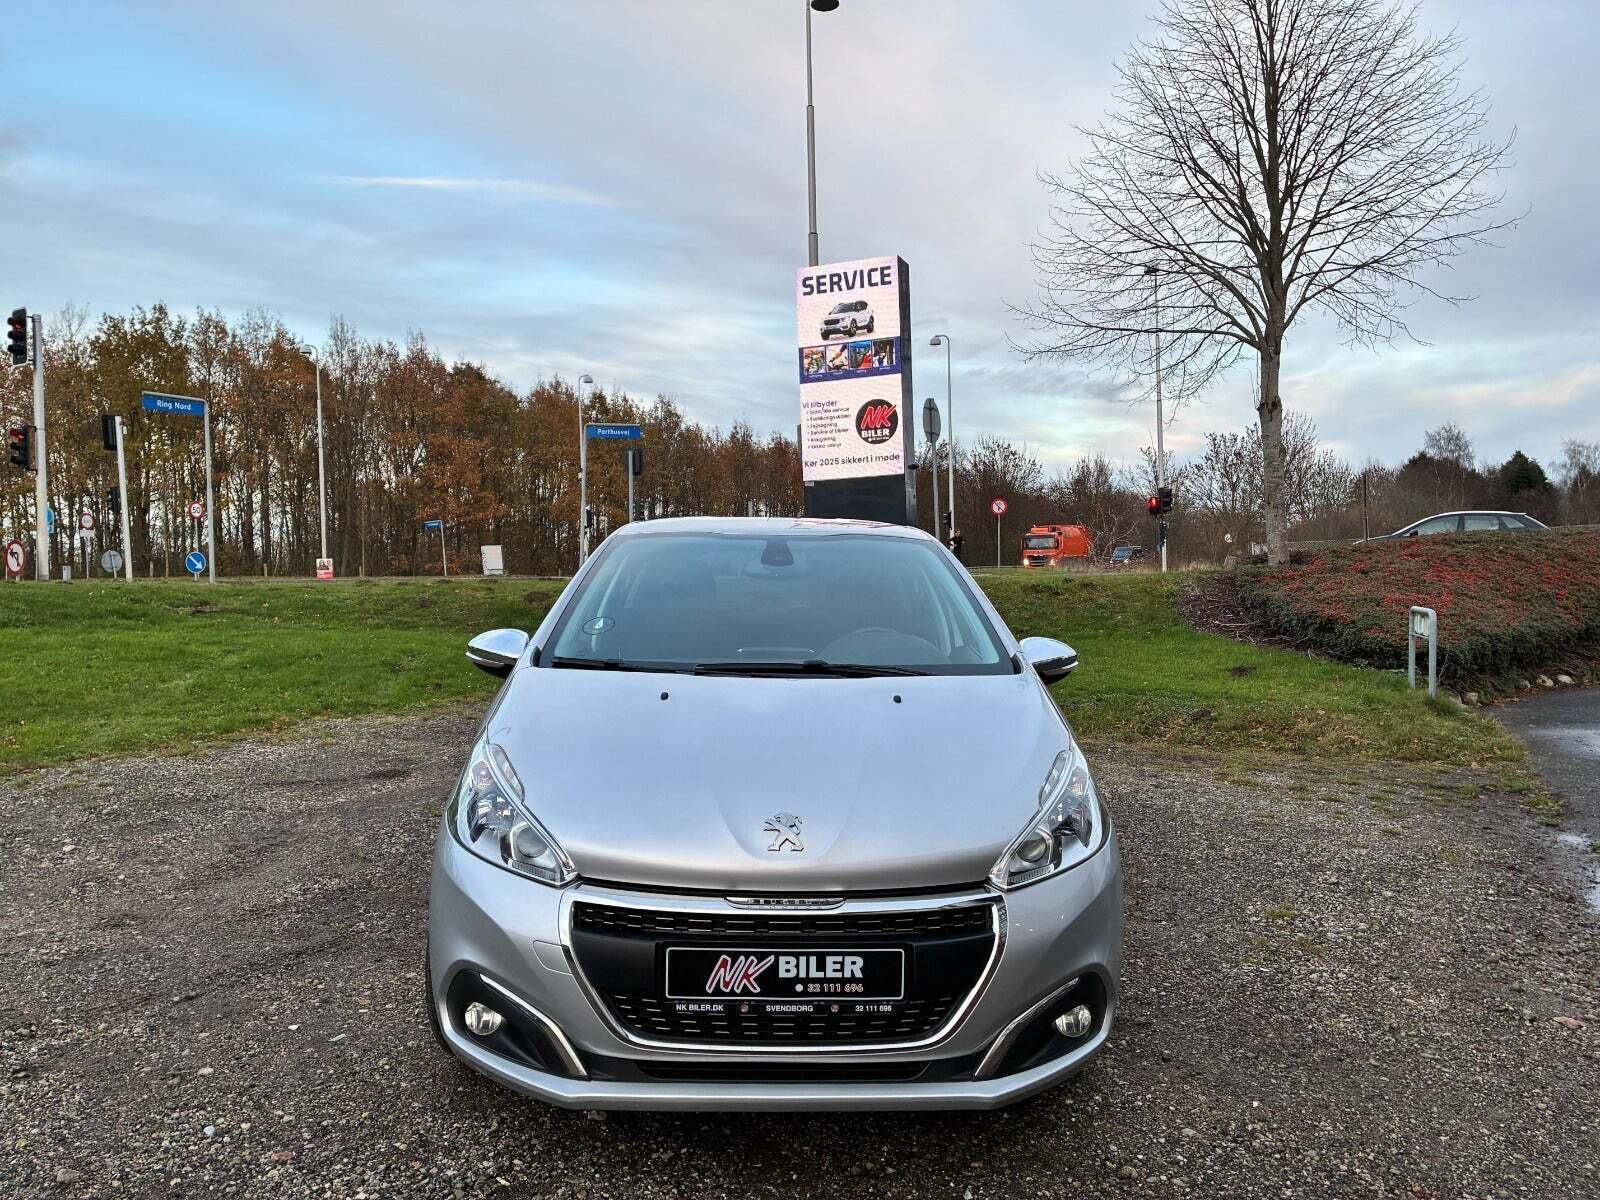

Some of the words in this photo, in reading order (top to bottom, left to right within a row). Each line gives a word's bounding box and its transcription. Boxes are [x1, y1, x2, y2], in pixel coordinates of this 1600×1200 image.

[802, 266, 891, 296] SERVICE
[156, 399, 173, 409] Ring
[174, 401, 191, 410] Nord
[861, 404, 896, 429] NK
[861, 429, 890, 437] BILER
[820, 458, 840, 466] 2025
[841, 455, 869, 464] sikkert
[875, 453, 900, 461] møde
[705, 954, 775, 993] NK
[778, 955, 864, 978] BILER
[807, 983, 821, 993] 32
[823, 983, 841, 993] 111
[844, 983, 864, 993] 696
[676, 1003, 688, 1011] NK
[688, 1004, 724, 1012] BILER.DK
